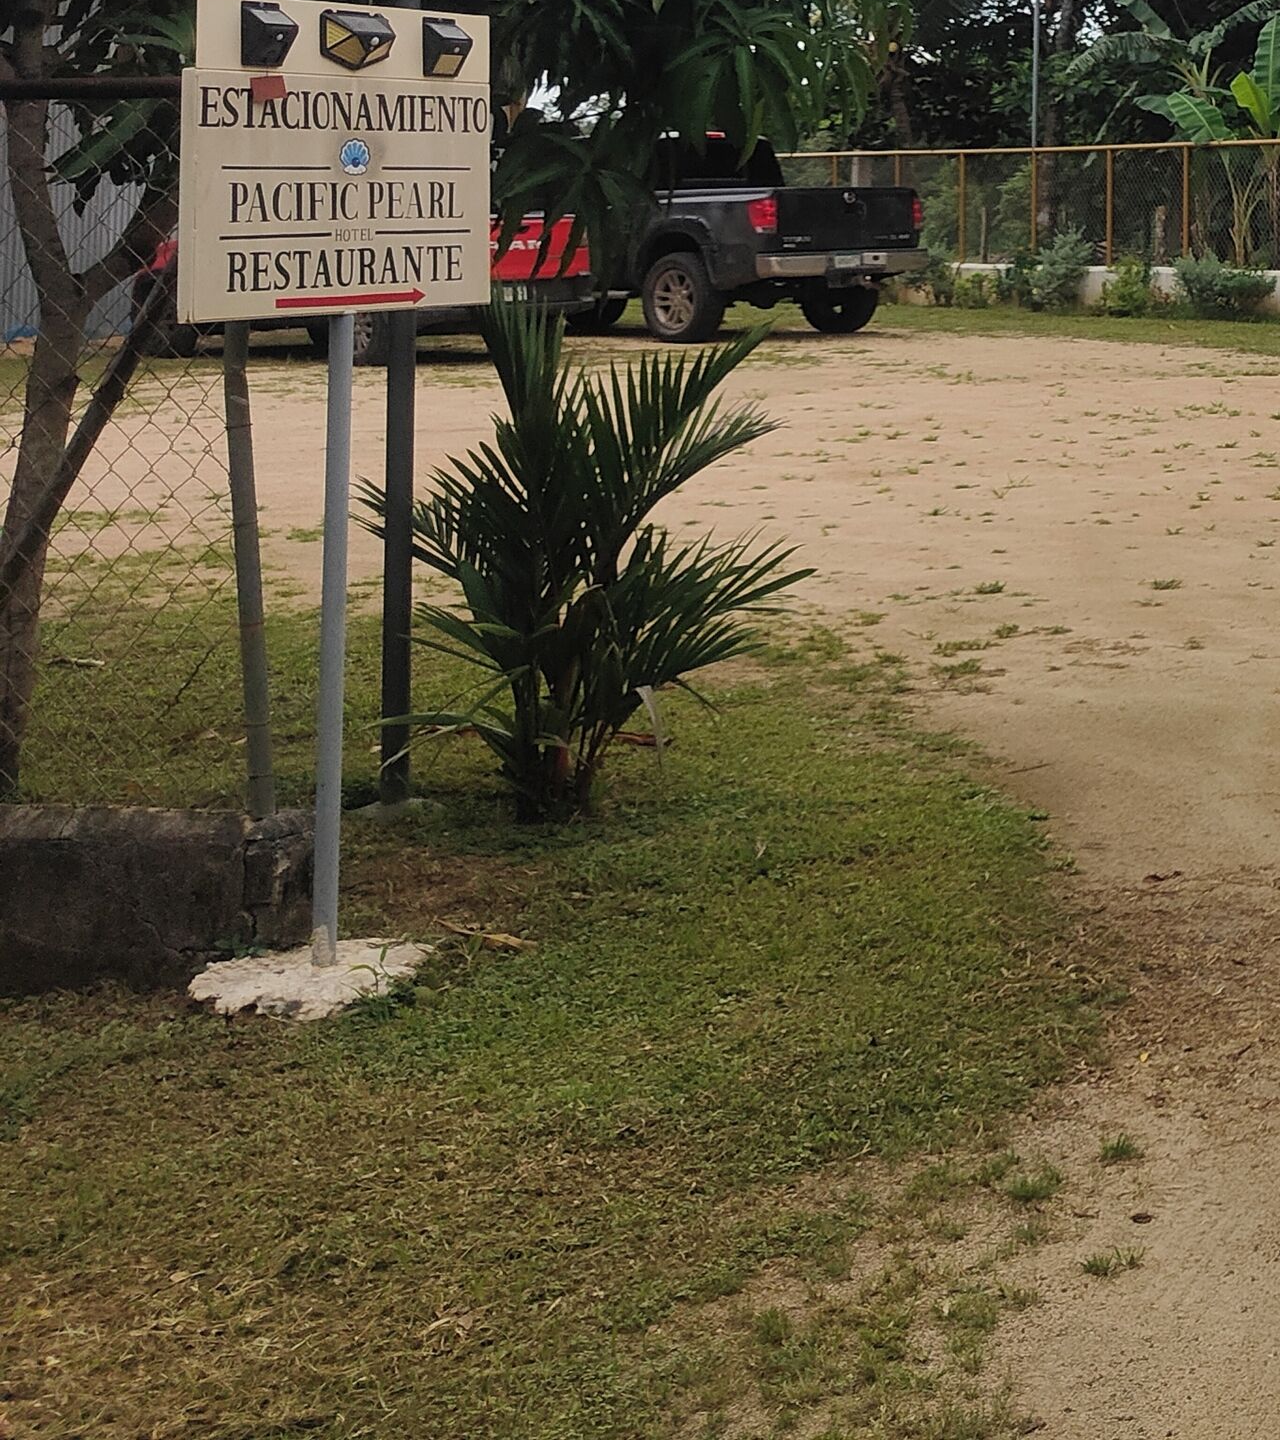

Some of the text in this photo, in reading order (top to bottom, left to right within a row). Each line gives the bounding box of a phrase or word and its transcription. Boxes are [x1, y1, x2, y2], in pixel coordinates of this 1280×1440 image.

[198, 86, 488, 133] ESTACIONAMIENTO
[228, 181, 464, 223] PACIFIC PEARL
[334, 228, 374, 242] HOTEL
[226, 244, 464, 293] RESTAURANTE
